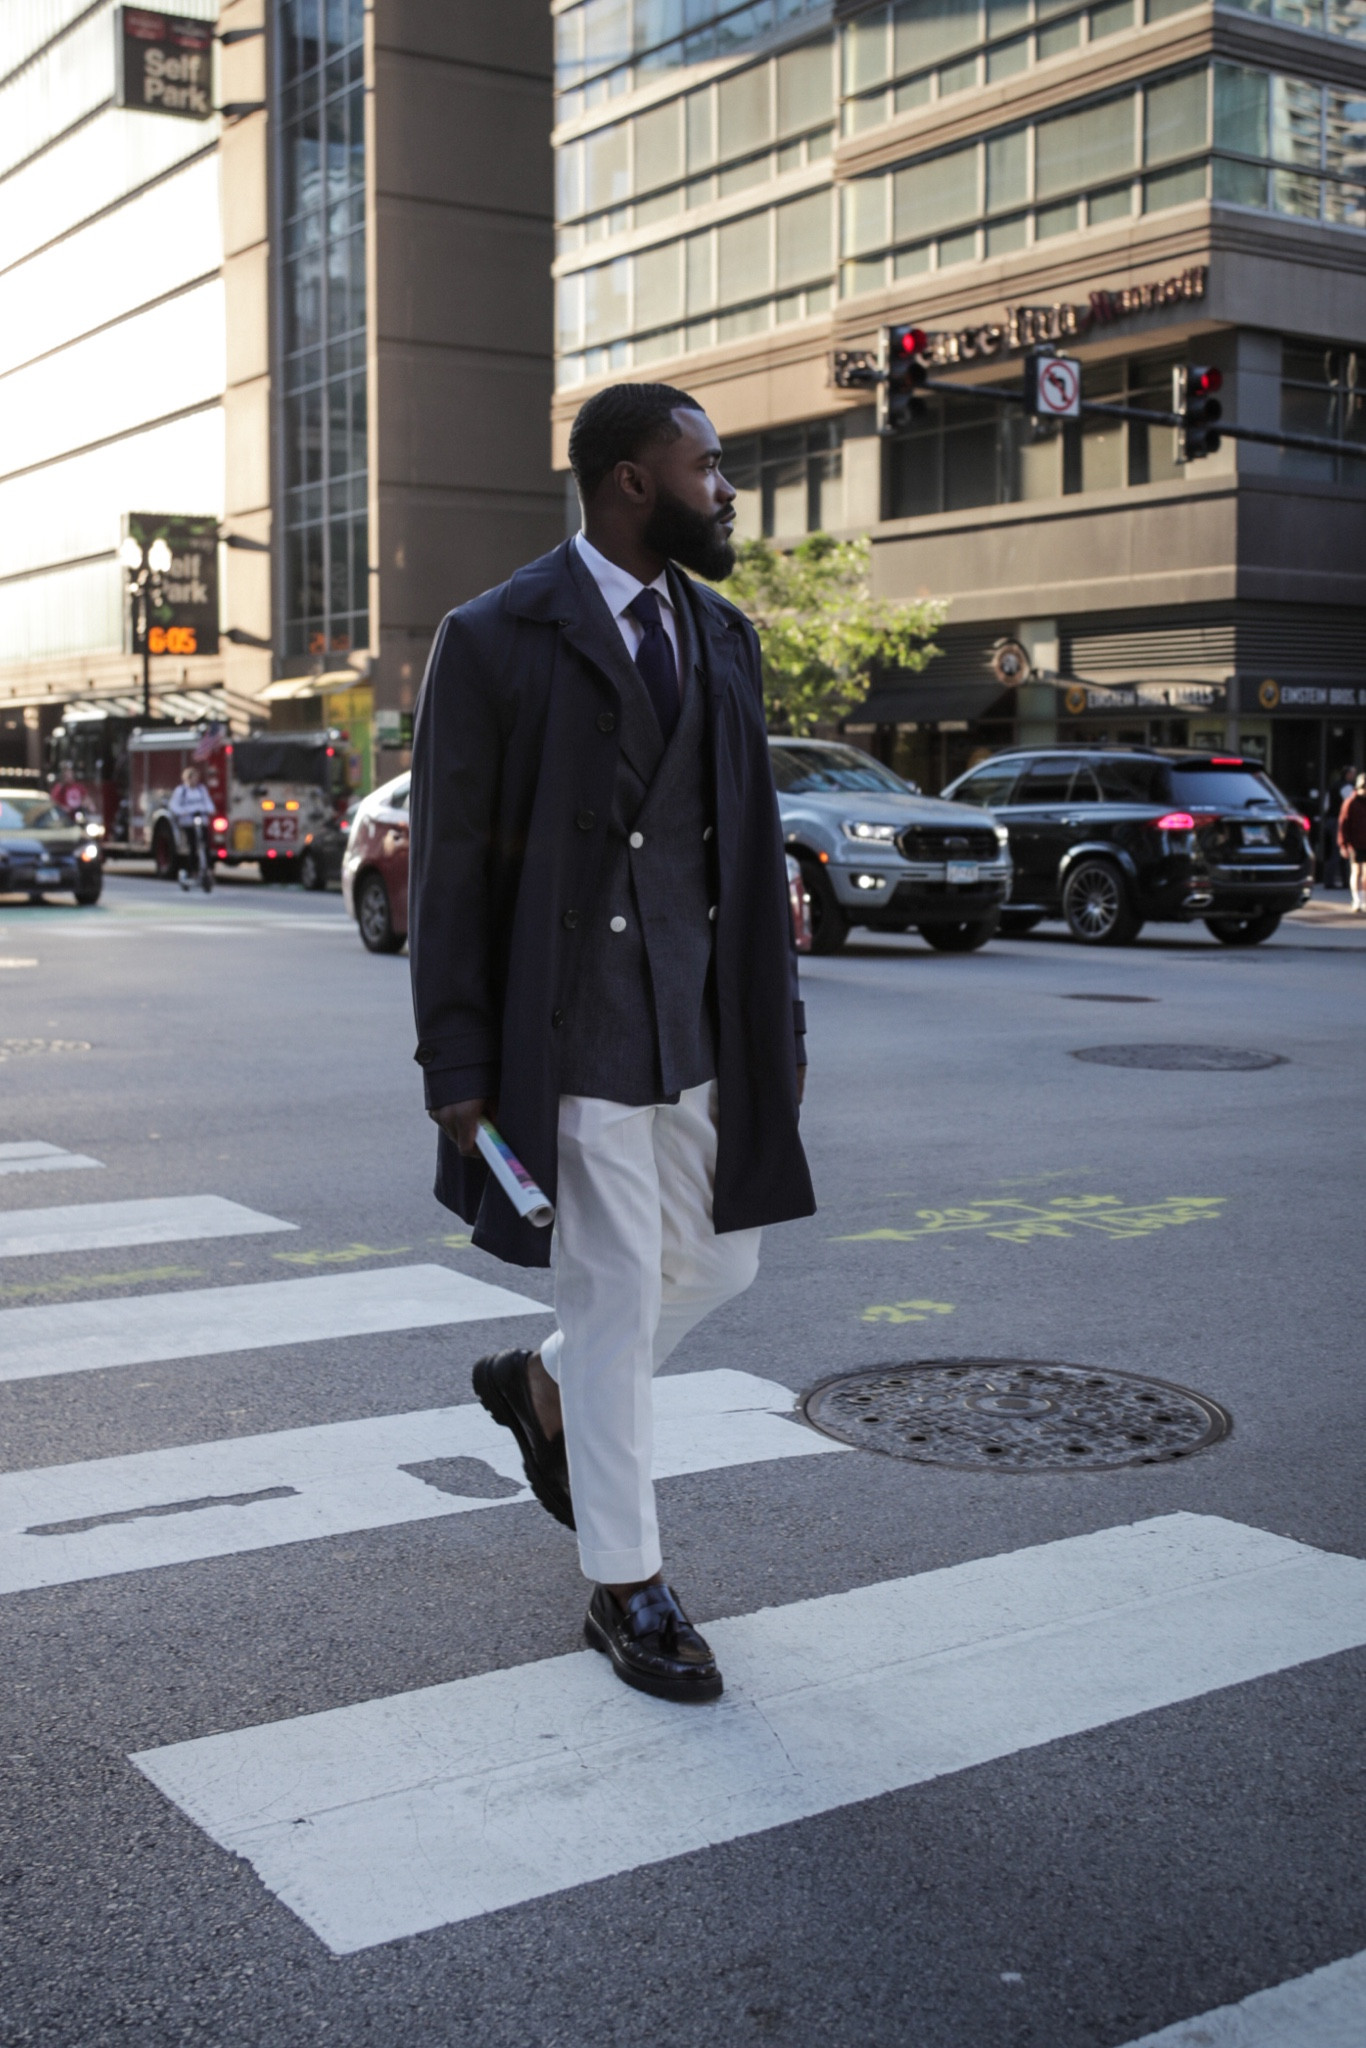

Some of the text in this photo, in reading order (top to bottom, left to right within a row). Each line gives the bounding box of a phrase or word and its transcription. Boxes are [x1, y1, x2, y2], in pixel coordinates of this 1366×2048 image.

[144, 48, 201, 83] Self
[144, 76, 206, 113] Park
[267, 820, 295, 839] 42
